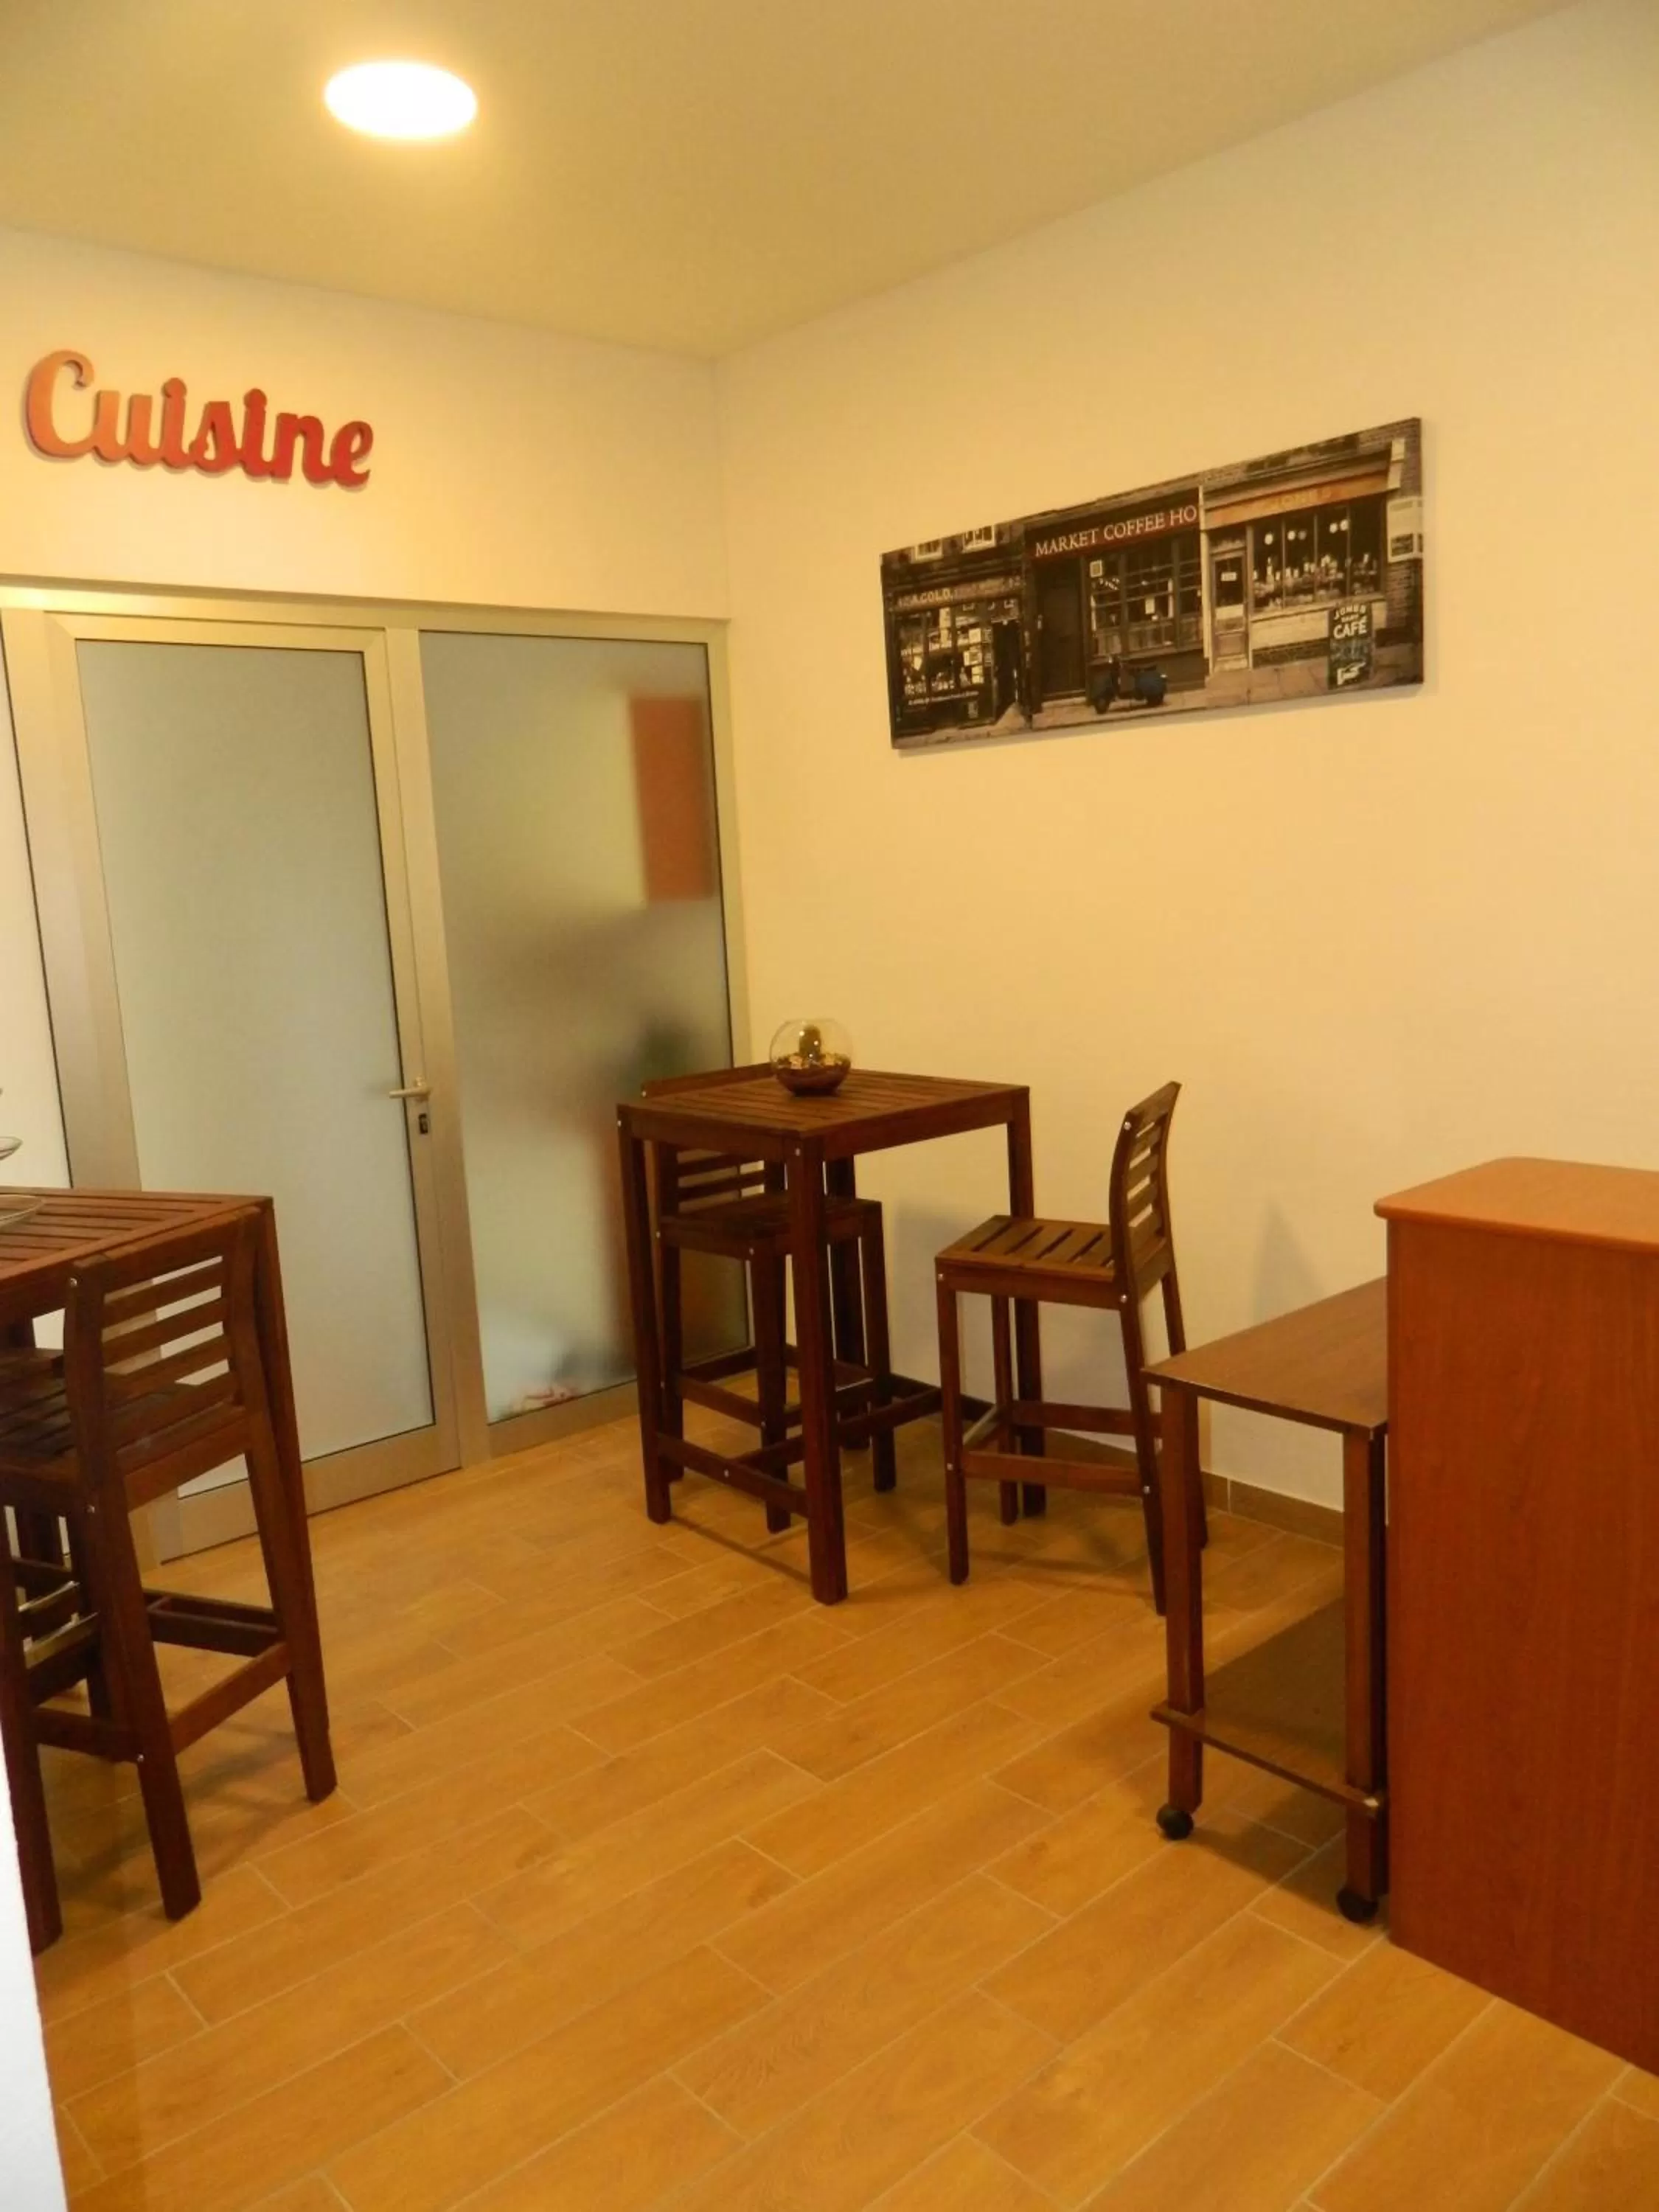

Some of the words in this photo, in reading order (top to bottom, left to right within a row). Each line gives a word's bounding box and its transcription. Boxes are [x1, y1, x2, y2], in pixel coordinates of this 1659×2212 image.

[27, 349, 374, 487] Cuisine
[1035, 528, 1099, 557] MARKET
[1104, 512, 1166, 540] COFFEE
[1333, 616, 1367, 639] CAFÉ
